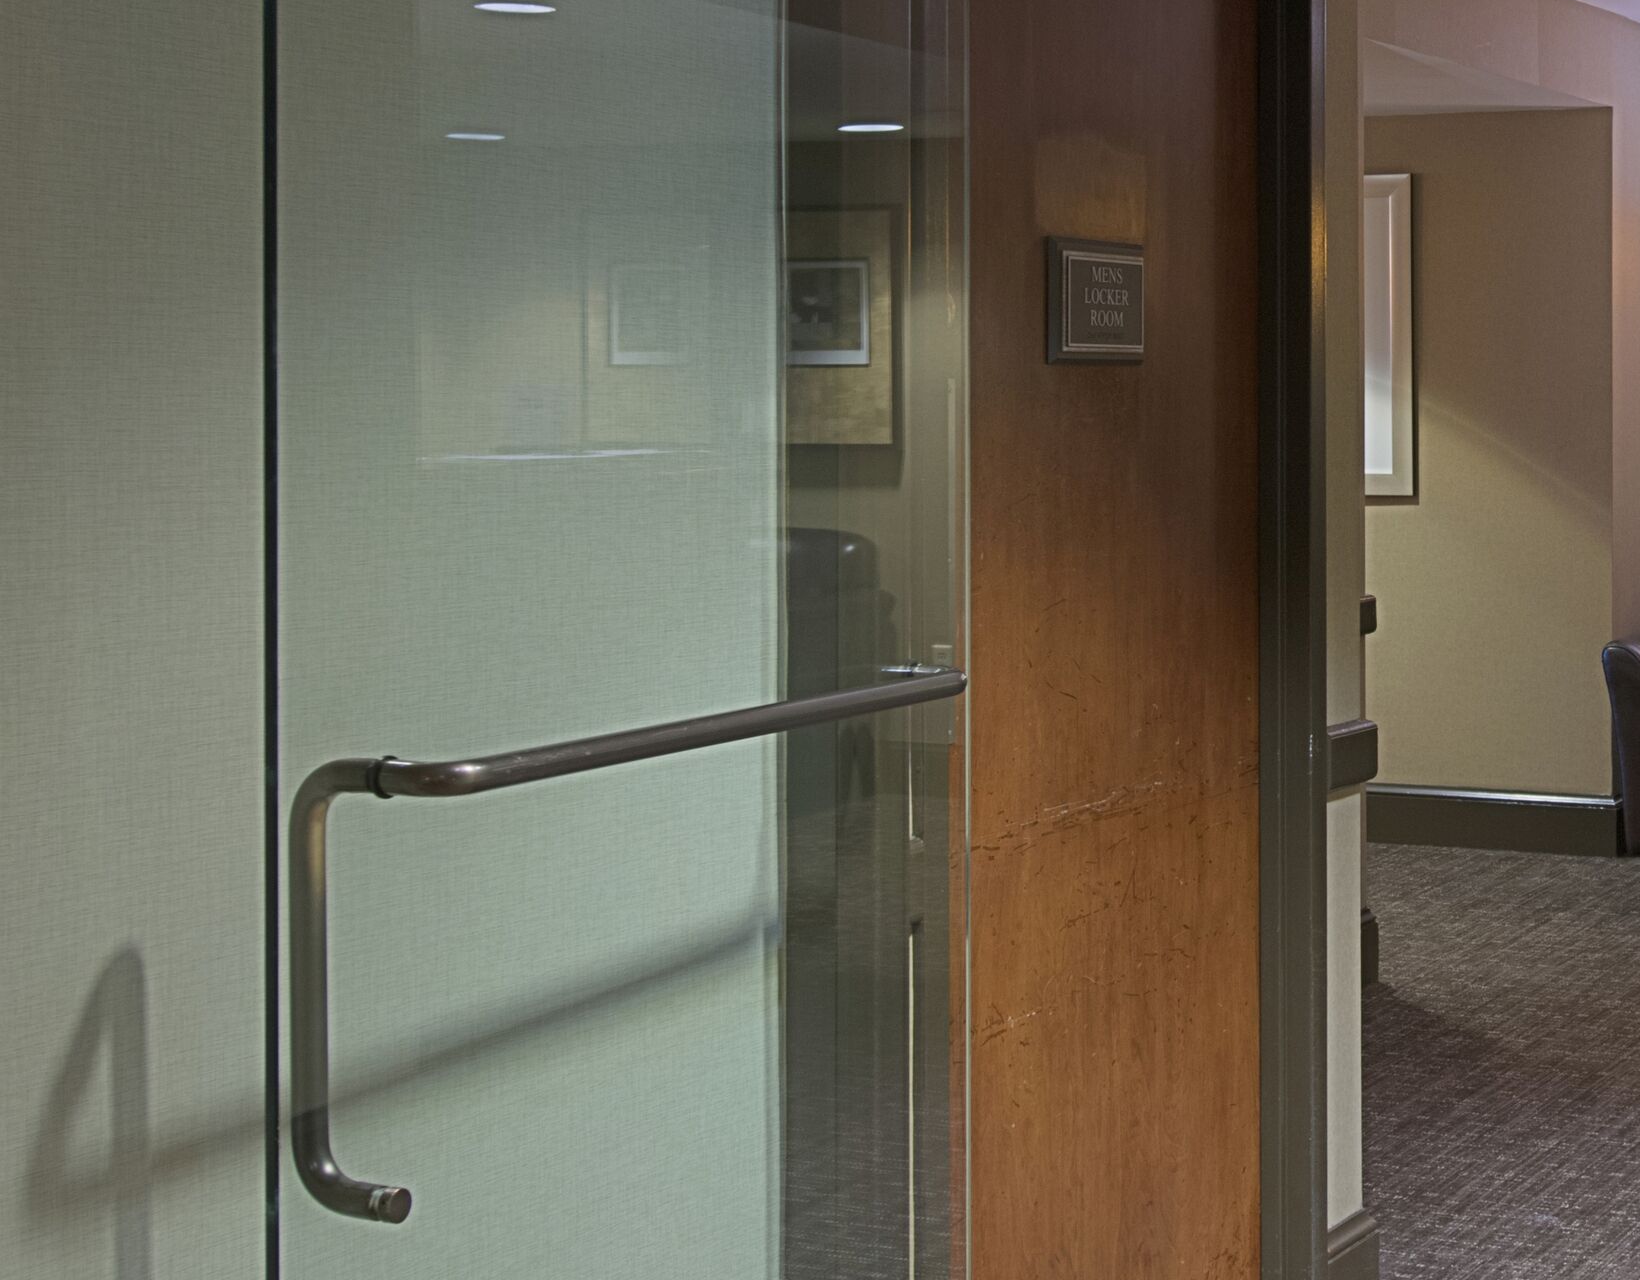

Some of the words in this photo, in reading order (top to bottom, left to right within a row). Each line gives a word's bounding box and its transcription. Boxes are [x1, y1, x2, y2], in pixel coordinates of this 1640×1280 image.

[1091, 266, 1123, 284] MENS
[1084, 287, 1129, 306] LOCKER
[1090, 309, 1124, 327] ROOM
